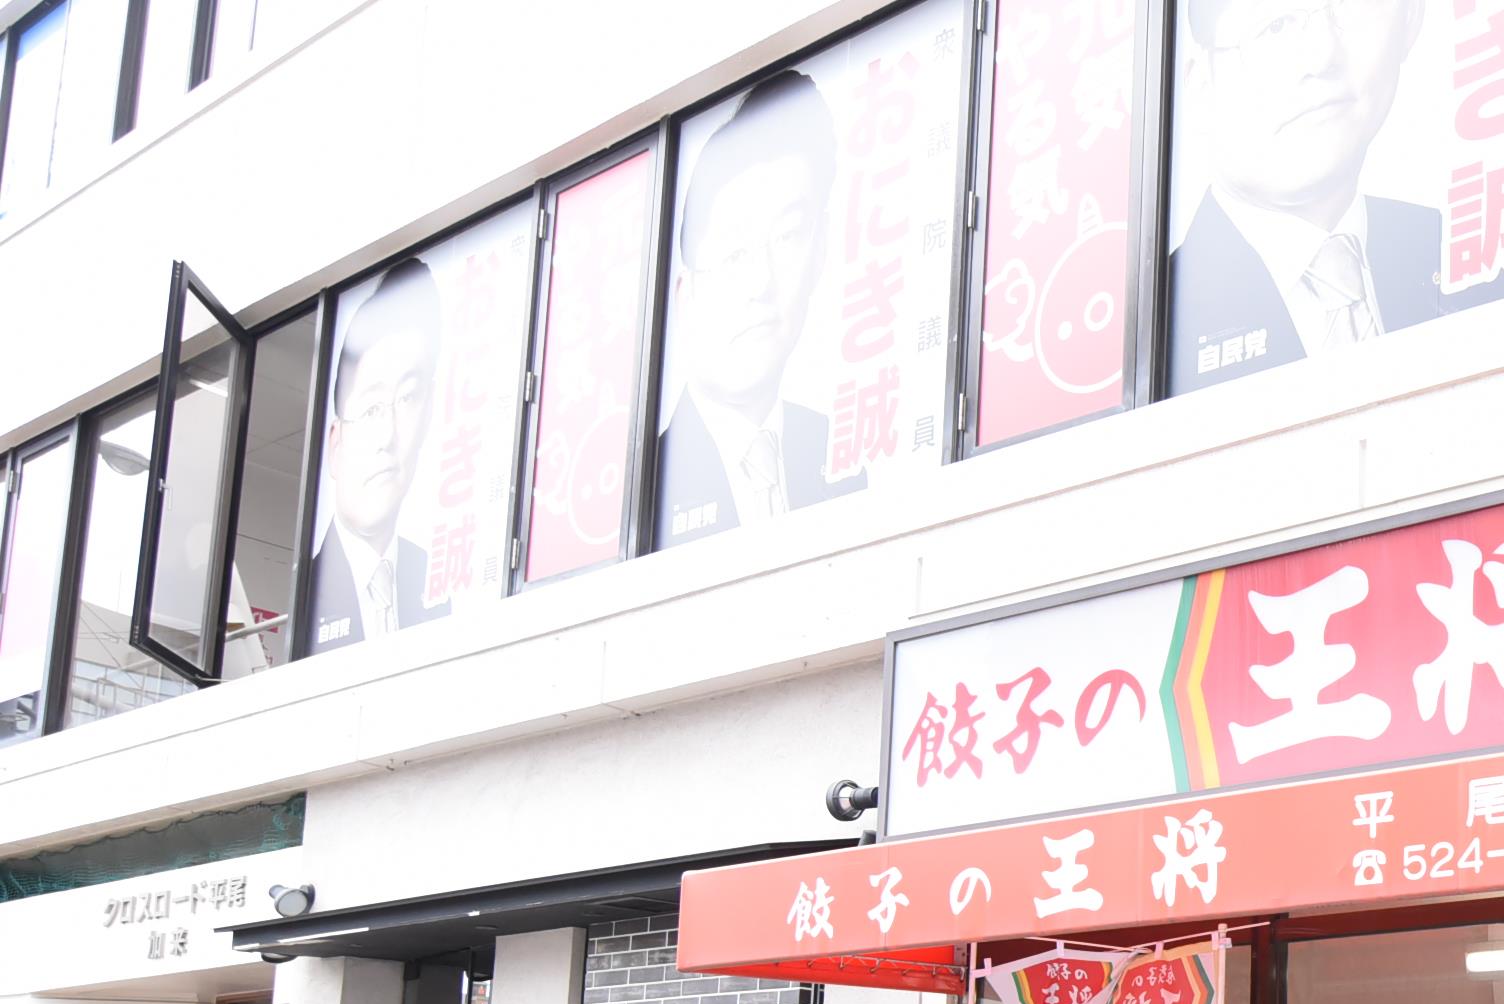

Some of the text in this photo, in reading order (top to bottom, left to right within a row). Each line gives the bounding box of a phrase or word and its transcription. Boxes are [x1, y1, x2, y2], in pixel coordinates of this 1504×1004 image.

[832, 51, 920, 475] おにき誠
[911, 28, 957, 453] 衆議院議員
[1197, 329, 1267, 375] 自民党
[428, 249, 500, 602] おにき誠
[902, 666, 1146, 788] 餃子の
[103, 875, 248, 928] クロスロード平尾
[787, 809, 1227, 941] 餃子の 王将
